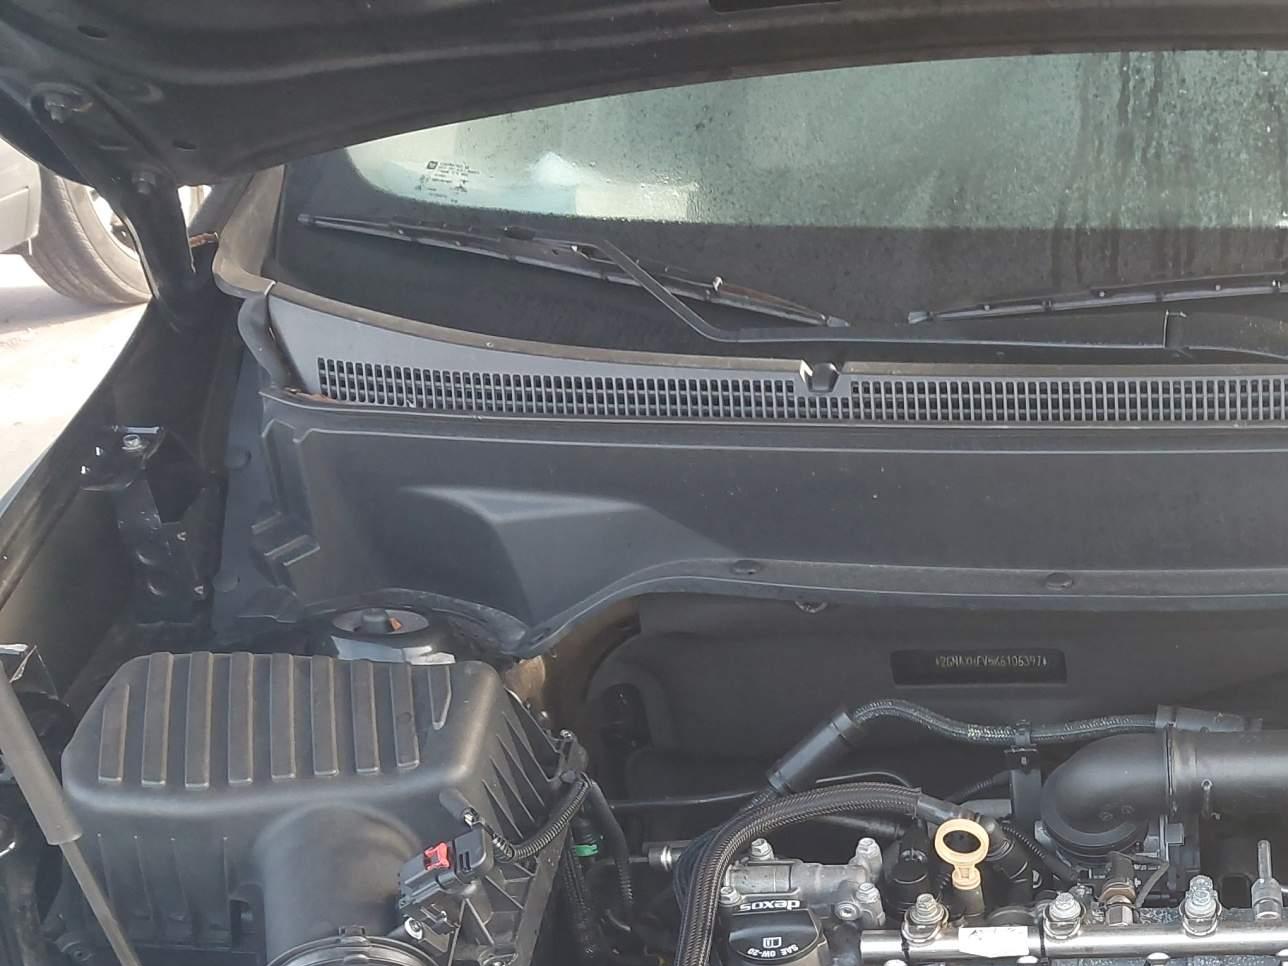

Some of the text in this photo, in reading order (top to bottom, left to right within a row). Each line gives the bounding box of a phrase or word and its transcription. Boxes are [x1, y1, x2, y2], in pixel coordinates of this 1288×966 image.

[739, 899, 801, 911] dexos
[747, 944, 799, 958] SAE 0W-20
